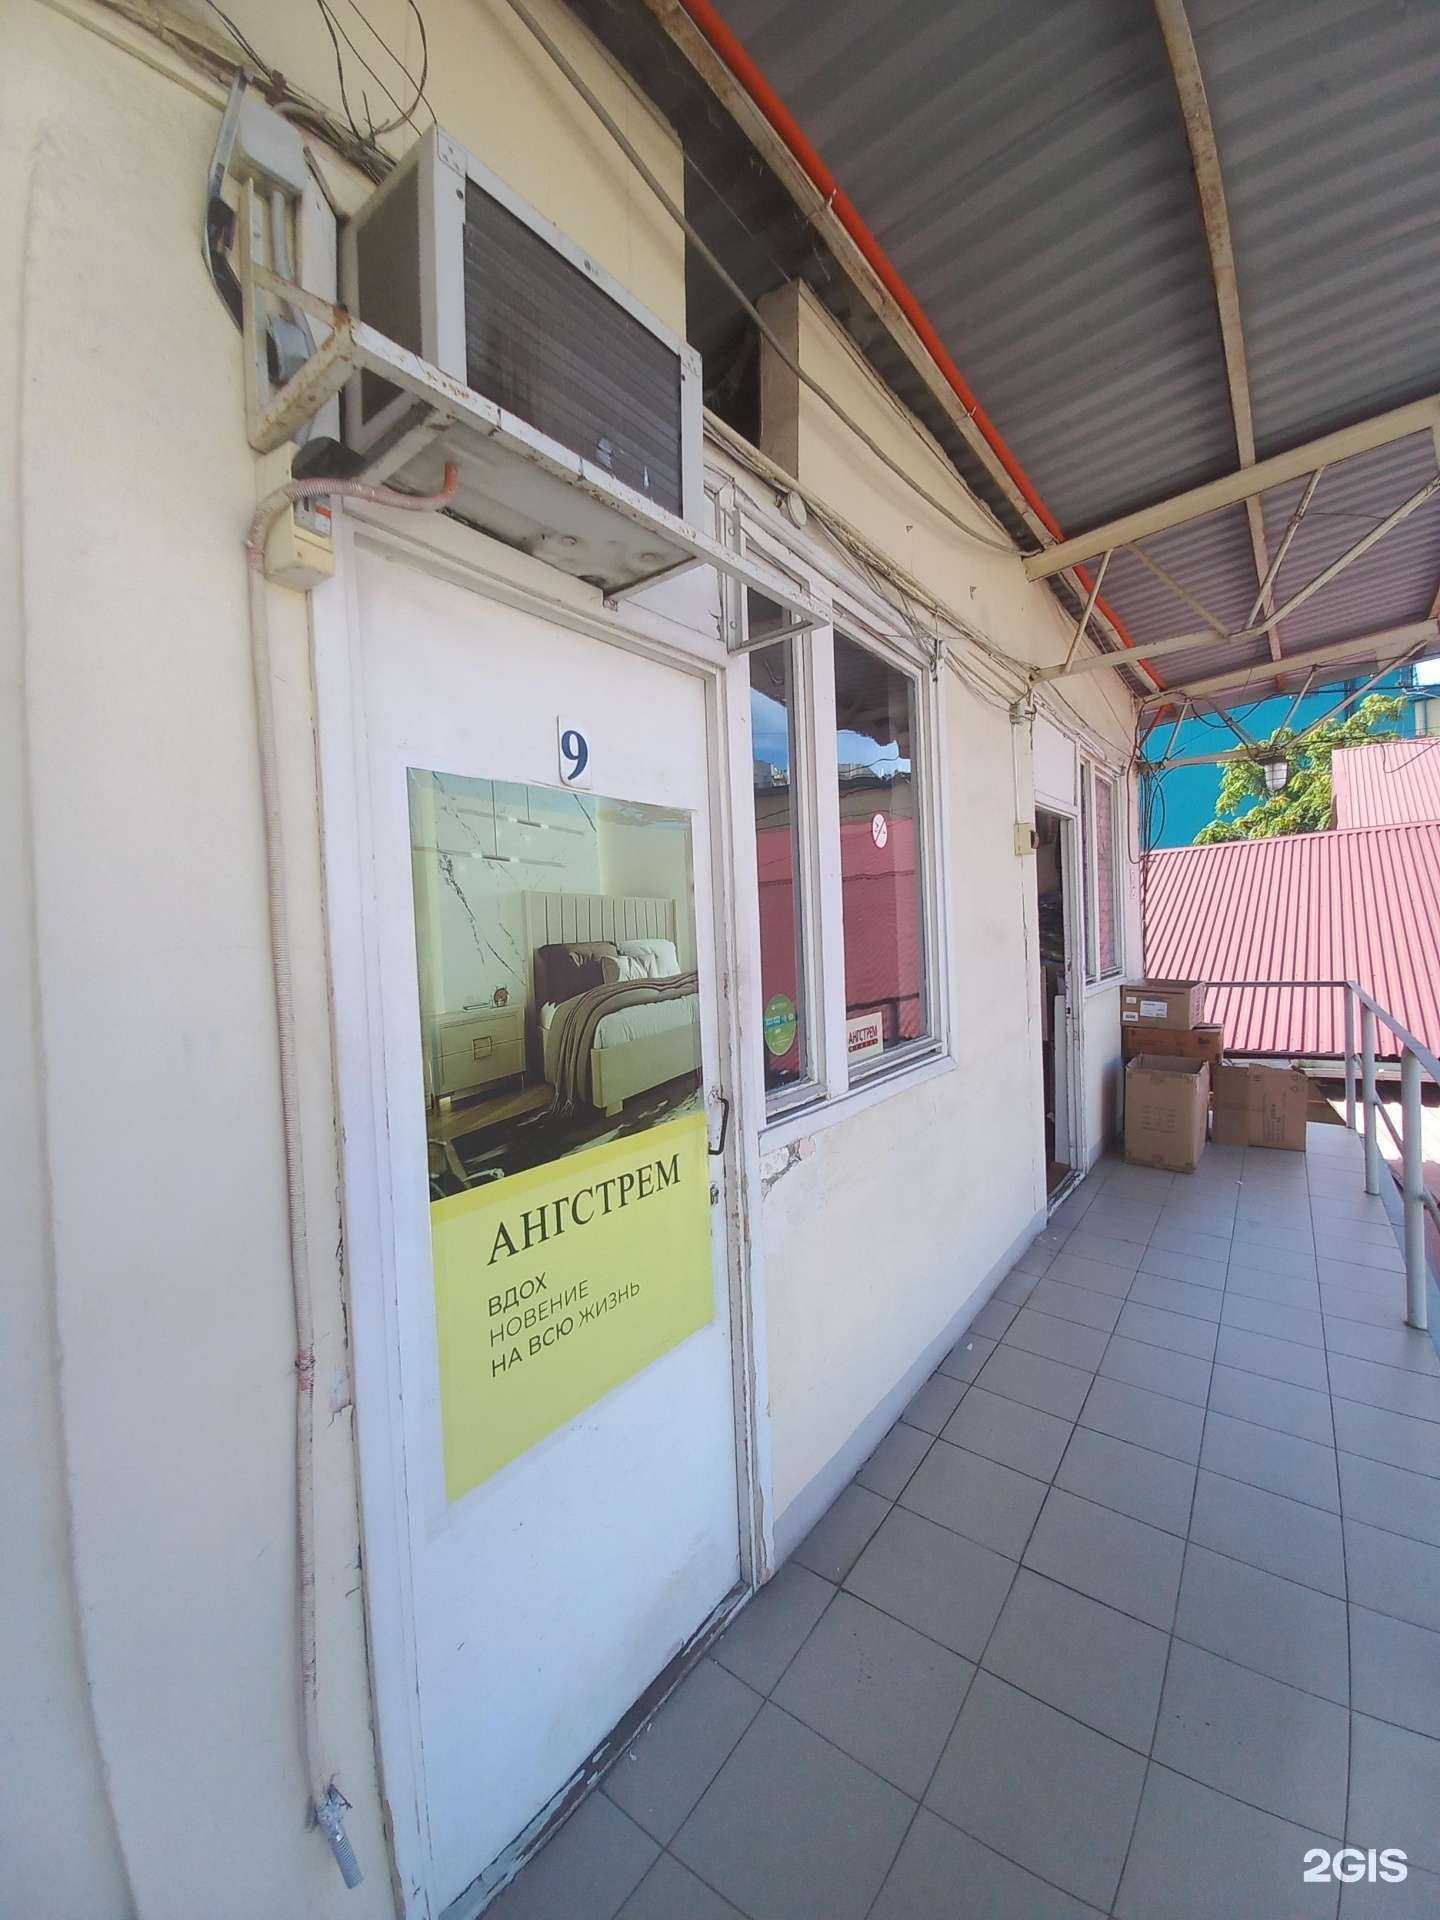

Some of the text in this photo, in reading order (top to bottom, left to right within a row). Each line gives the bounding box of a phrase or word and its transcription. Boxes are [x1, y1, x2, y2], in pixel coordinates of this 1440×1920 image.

[561, 730, 588, 780] 9
[487, 1153, 681, 1266] АНГСТРЕМ
[488, 1272, 547, 1317] ВДОХ
[490, 1280, 589, 1347] НОВЕНИЕ
[491, 1281, 640, 1378] НА ВСЮ ЖИЗНЬ
